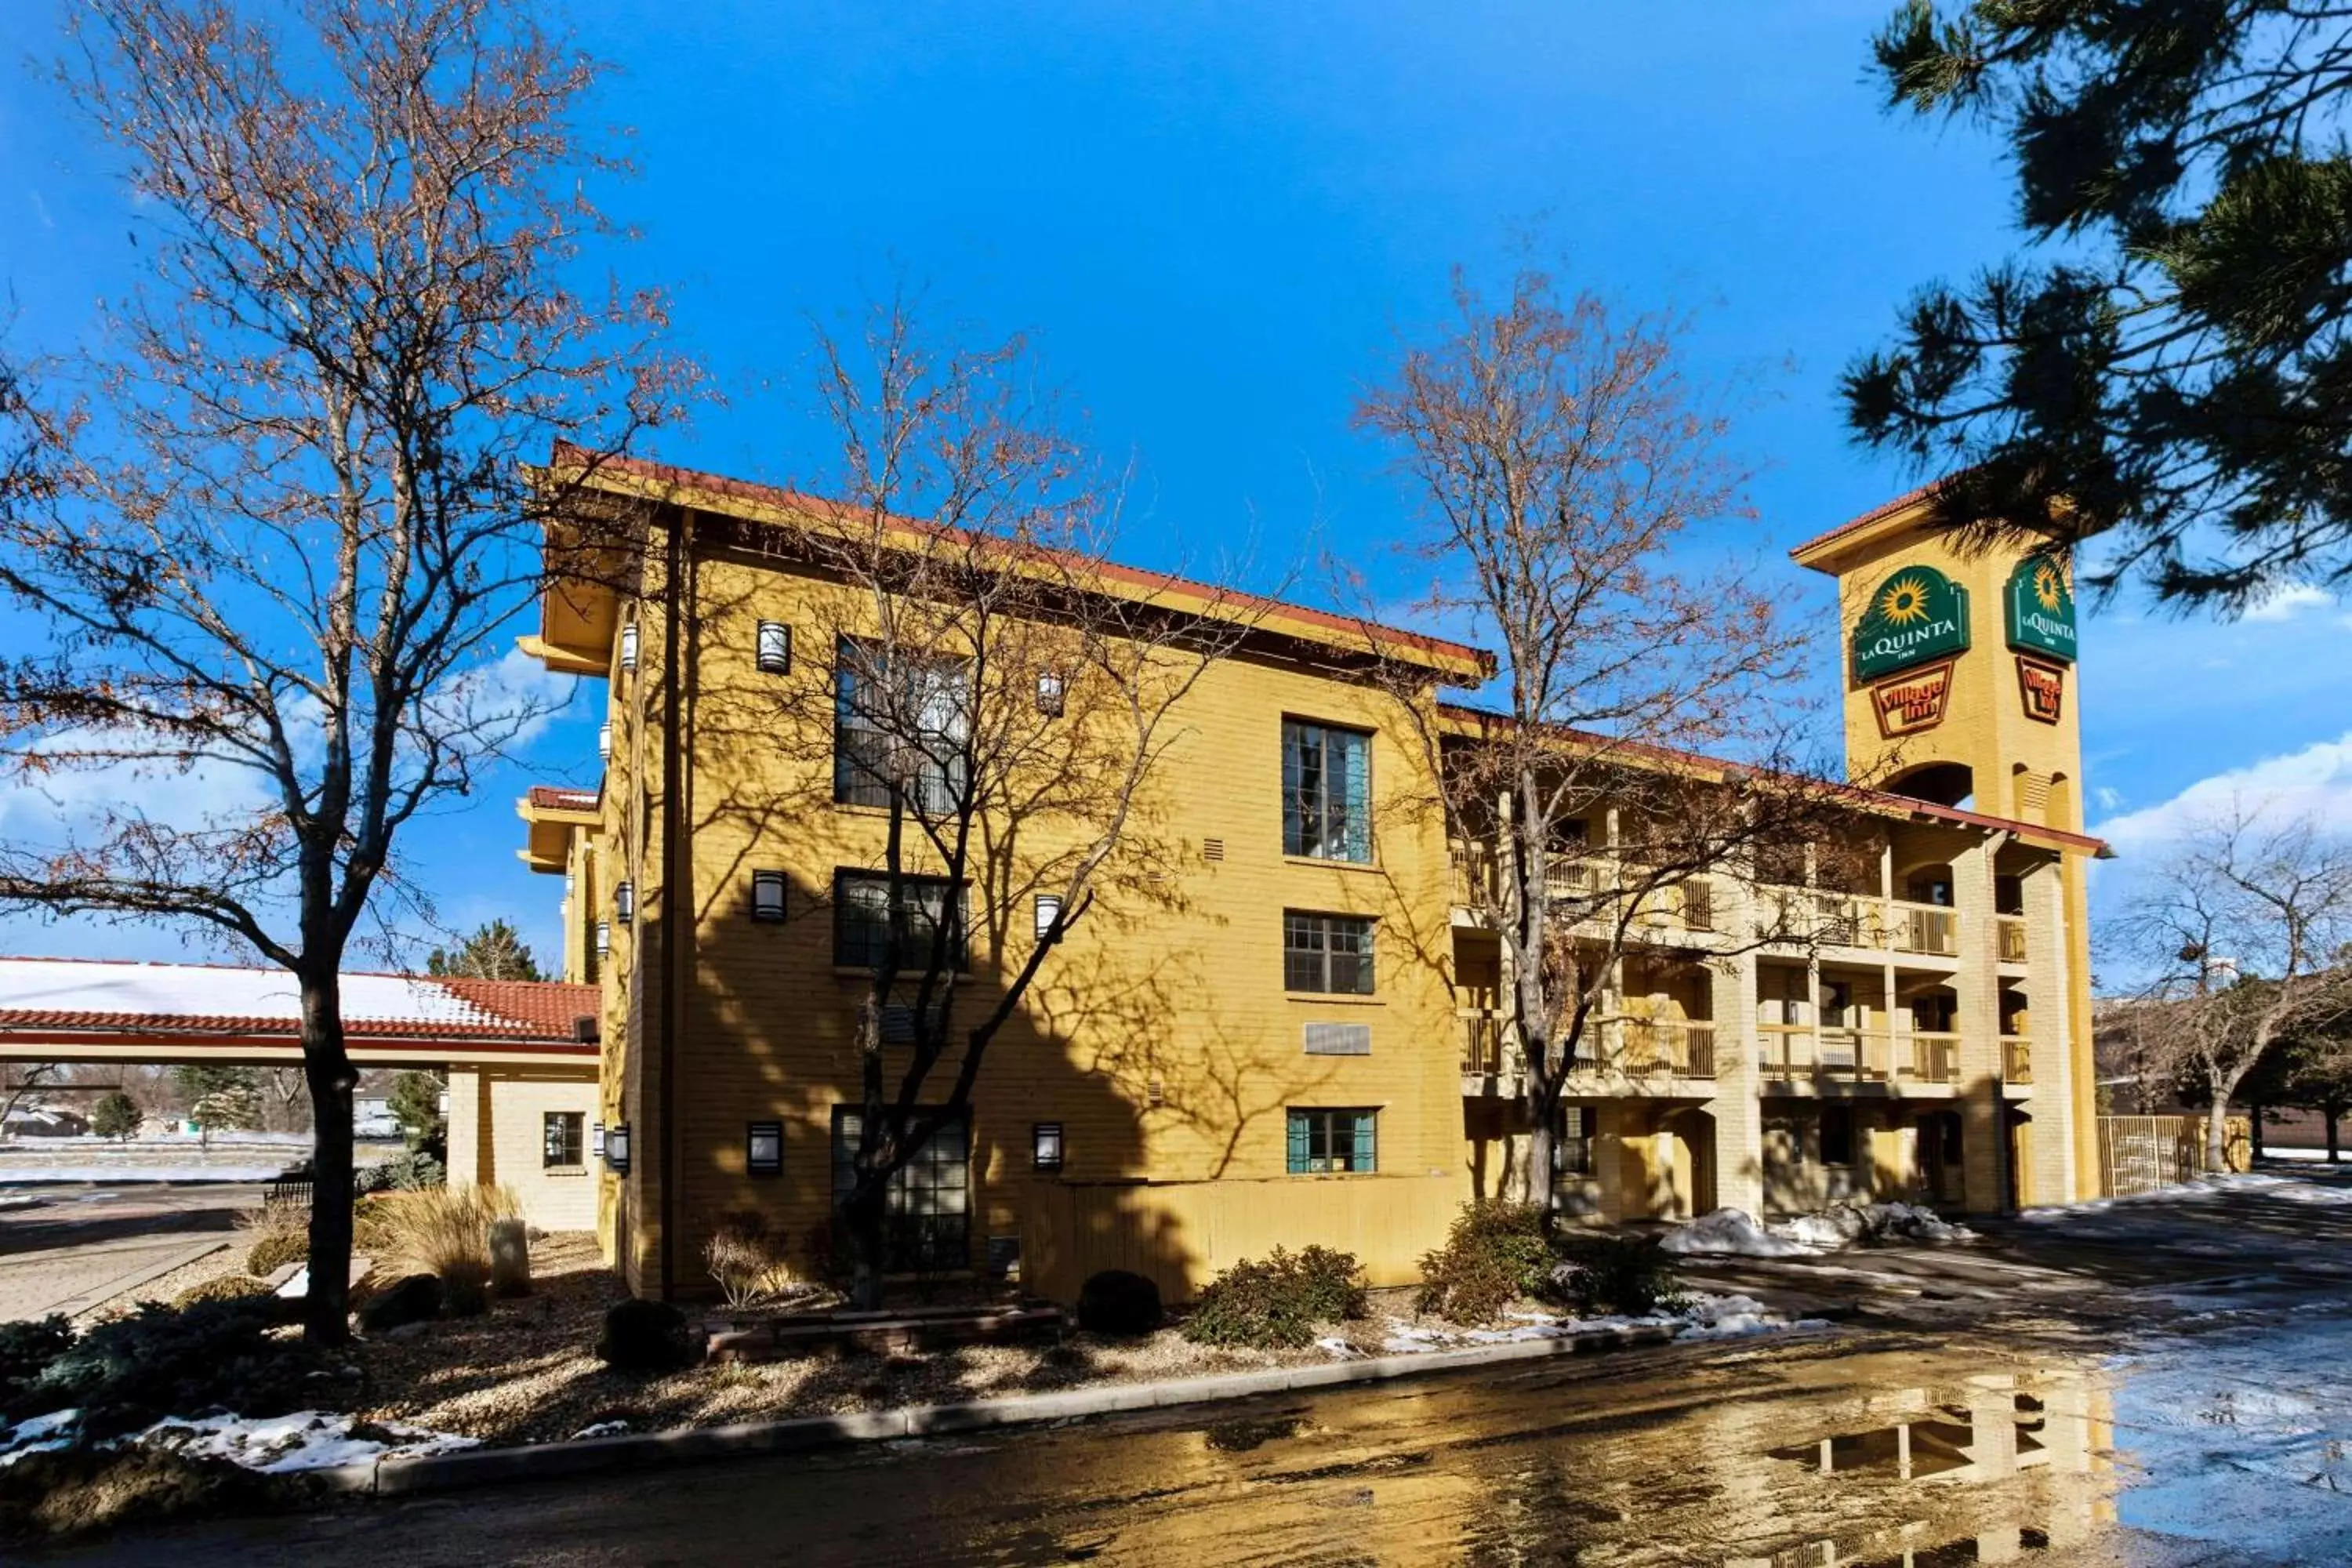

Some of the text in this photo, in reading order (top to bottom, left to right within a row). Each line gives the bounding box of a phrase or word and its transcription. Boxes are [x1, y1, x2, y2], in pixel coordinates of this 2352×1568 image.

[1862, 619, 1955, 660] LA QUINTA
[2022, 612, 2075, 641] LA QUINTA
[1898, 648, 1916, 660] INN
[1882, 681, 1943, 710] Village
